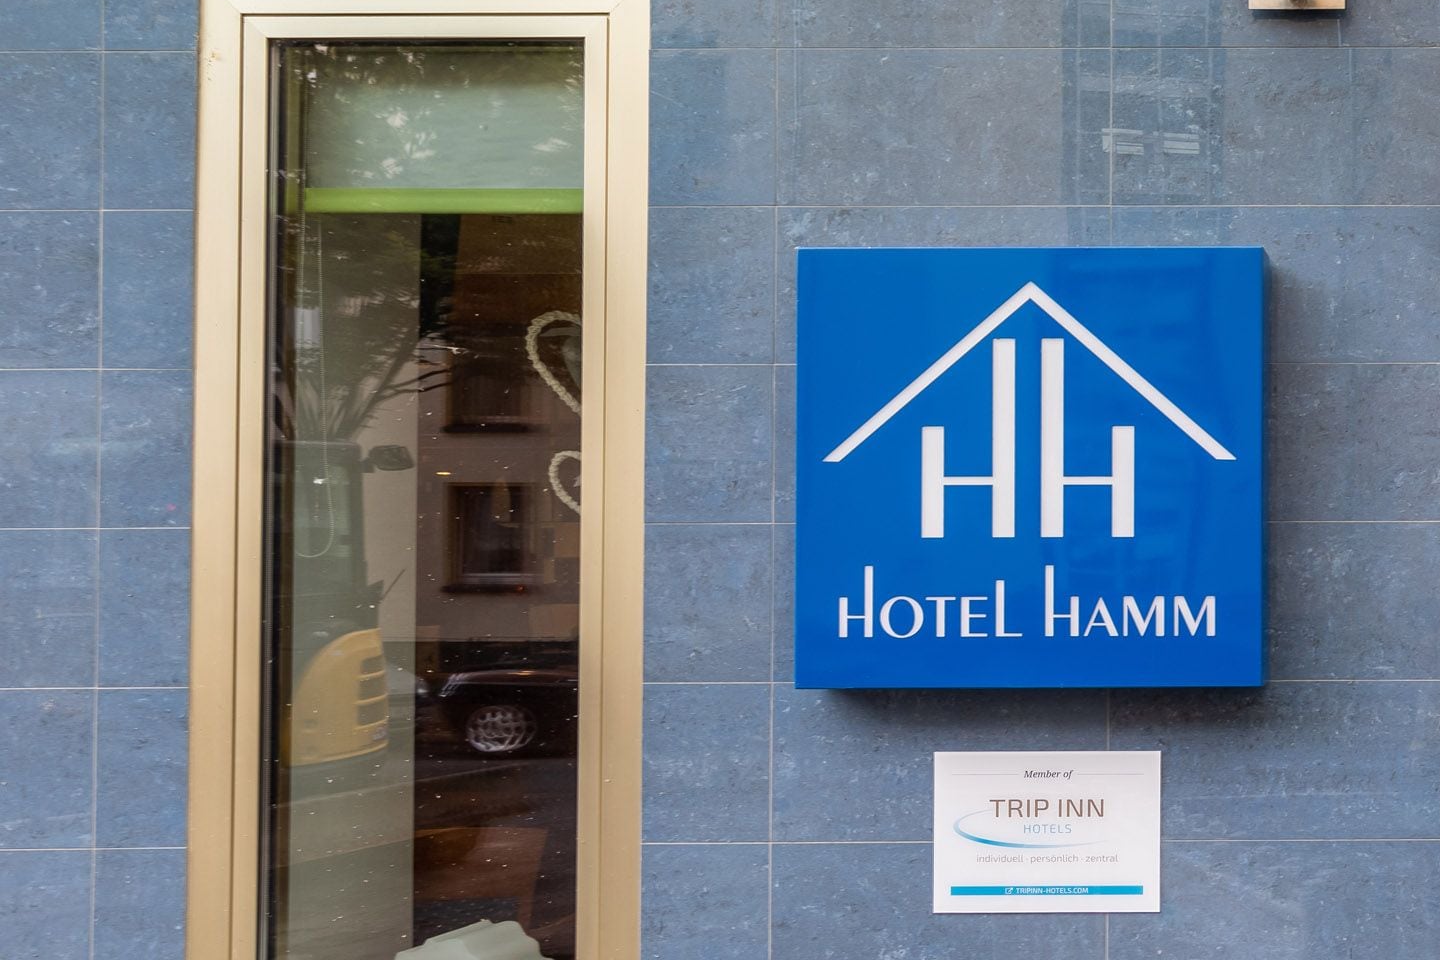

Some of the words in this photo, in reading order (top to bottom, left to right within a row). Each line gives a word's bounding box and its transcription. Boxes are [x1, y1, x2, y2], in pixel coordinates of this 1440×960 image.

[921, 338, 1135, 538] HH
[838, 565, 1023, 639] HOTEL
[1045, 564, 1217, 638] HAMM
[1023, 769, 1062, 779] Member
[1062, 769, 1075, 780] of
[989, 798, 1050, 818] TRIP
[1058, 798, 1105, 818] INN
[1023, 823, 1072, 834] HOTELS
[976, 853, 1024, 863] individuell
[1030, 853, 1079, 865] persönlich
[1085, 853, 1118, 863] zentral
[1015, 886, 1089, 895] TRIPINN-HOTELS.COM
